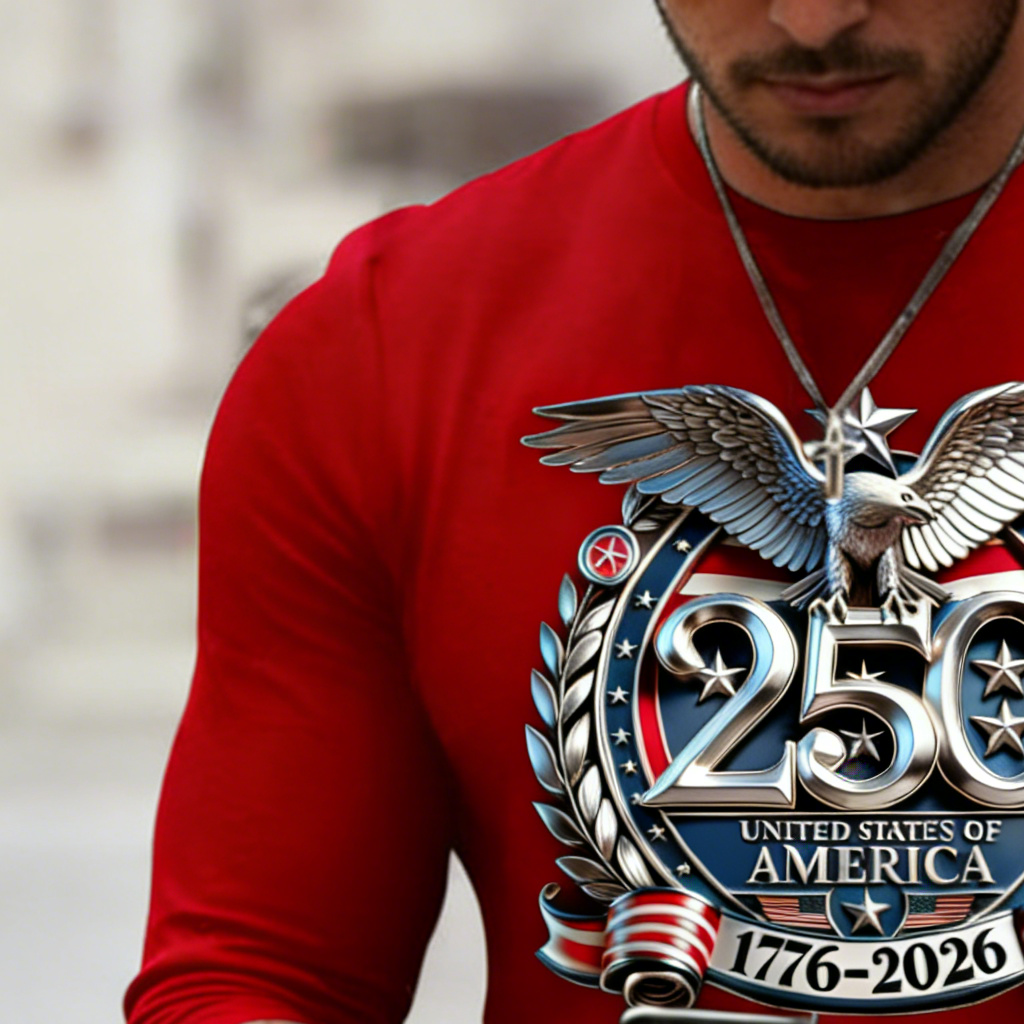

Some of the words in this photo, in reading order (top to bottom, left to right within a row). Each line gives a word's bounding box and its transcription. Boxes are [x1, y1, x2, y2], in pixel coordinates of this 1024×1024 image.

[740, 818, 850, 842] UNITED
[858, 818, 955, 842] STATES
[963, 818, 1002, 842] OF
[746, 844, 997, 885] AMERICA
[729, 927, 1007, 994] 1776-2026
